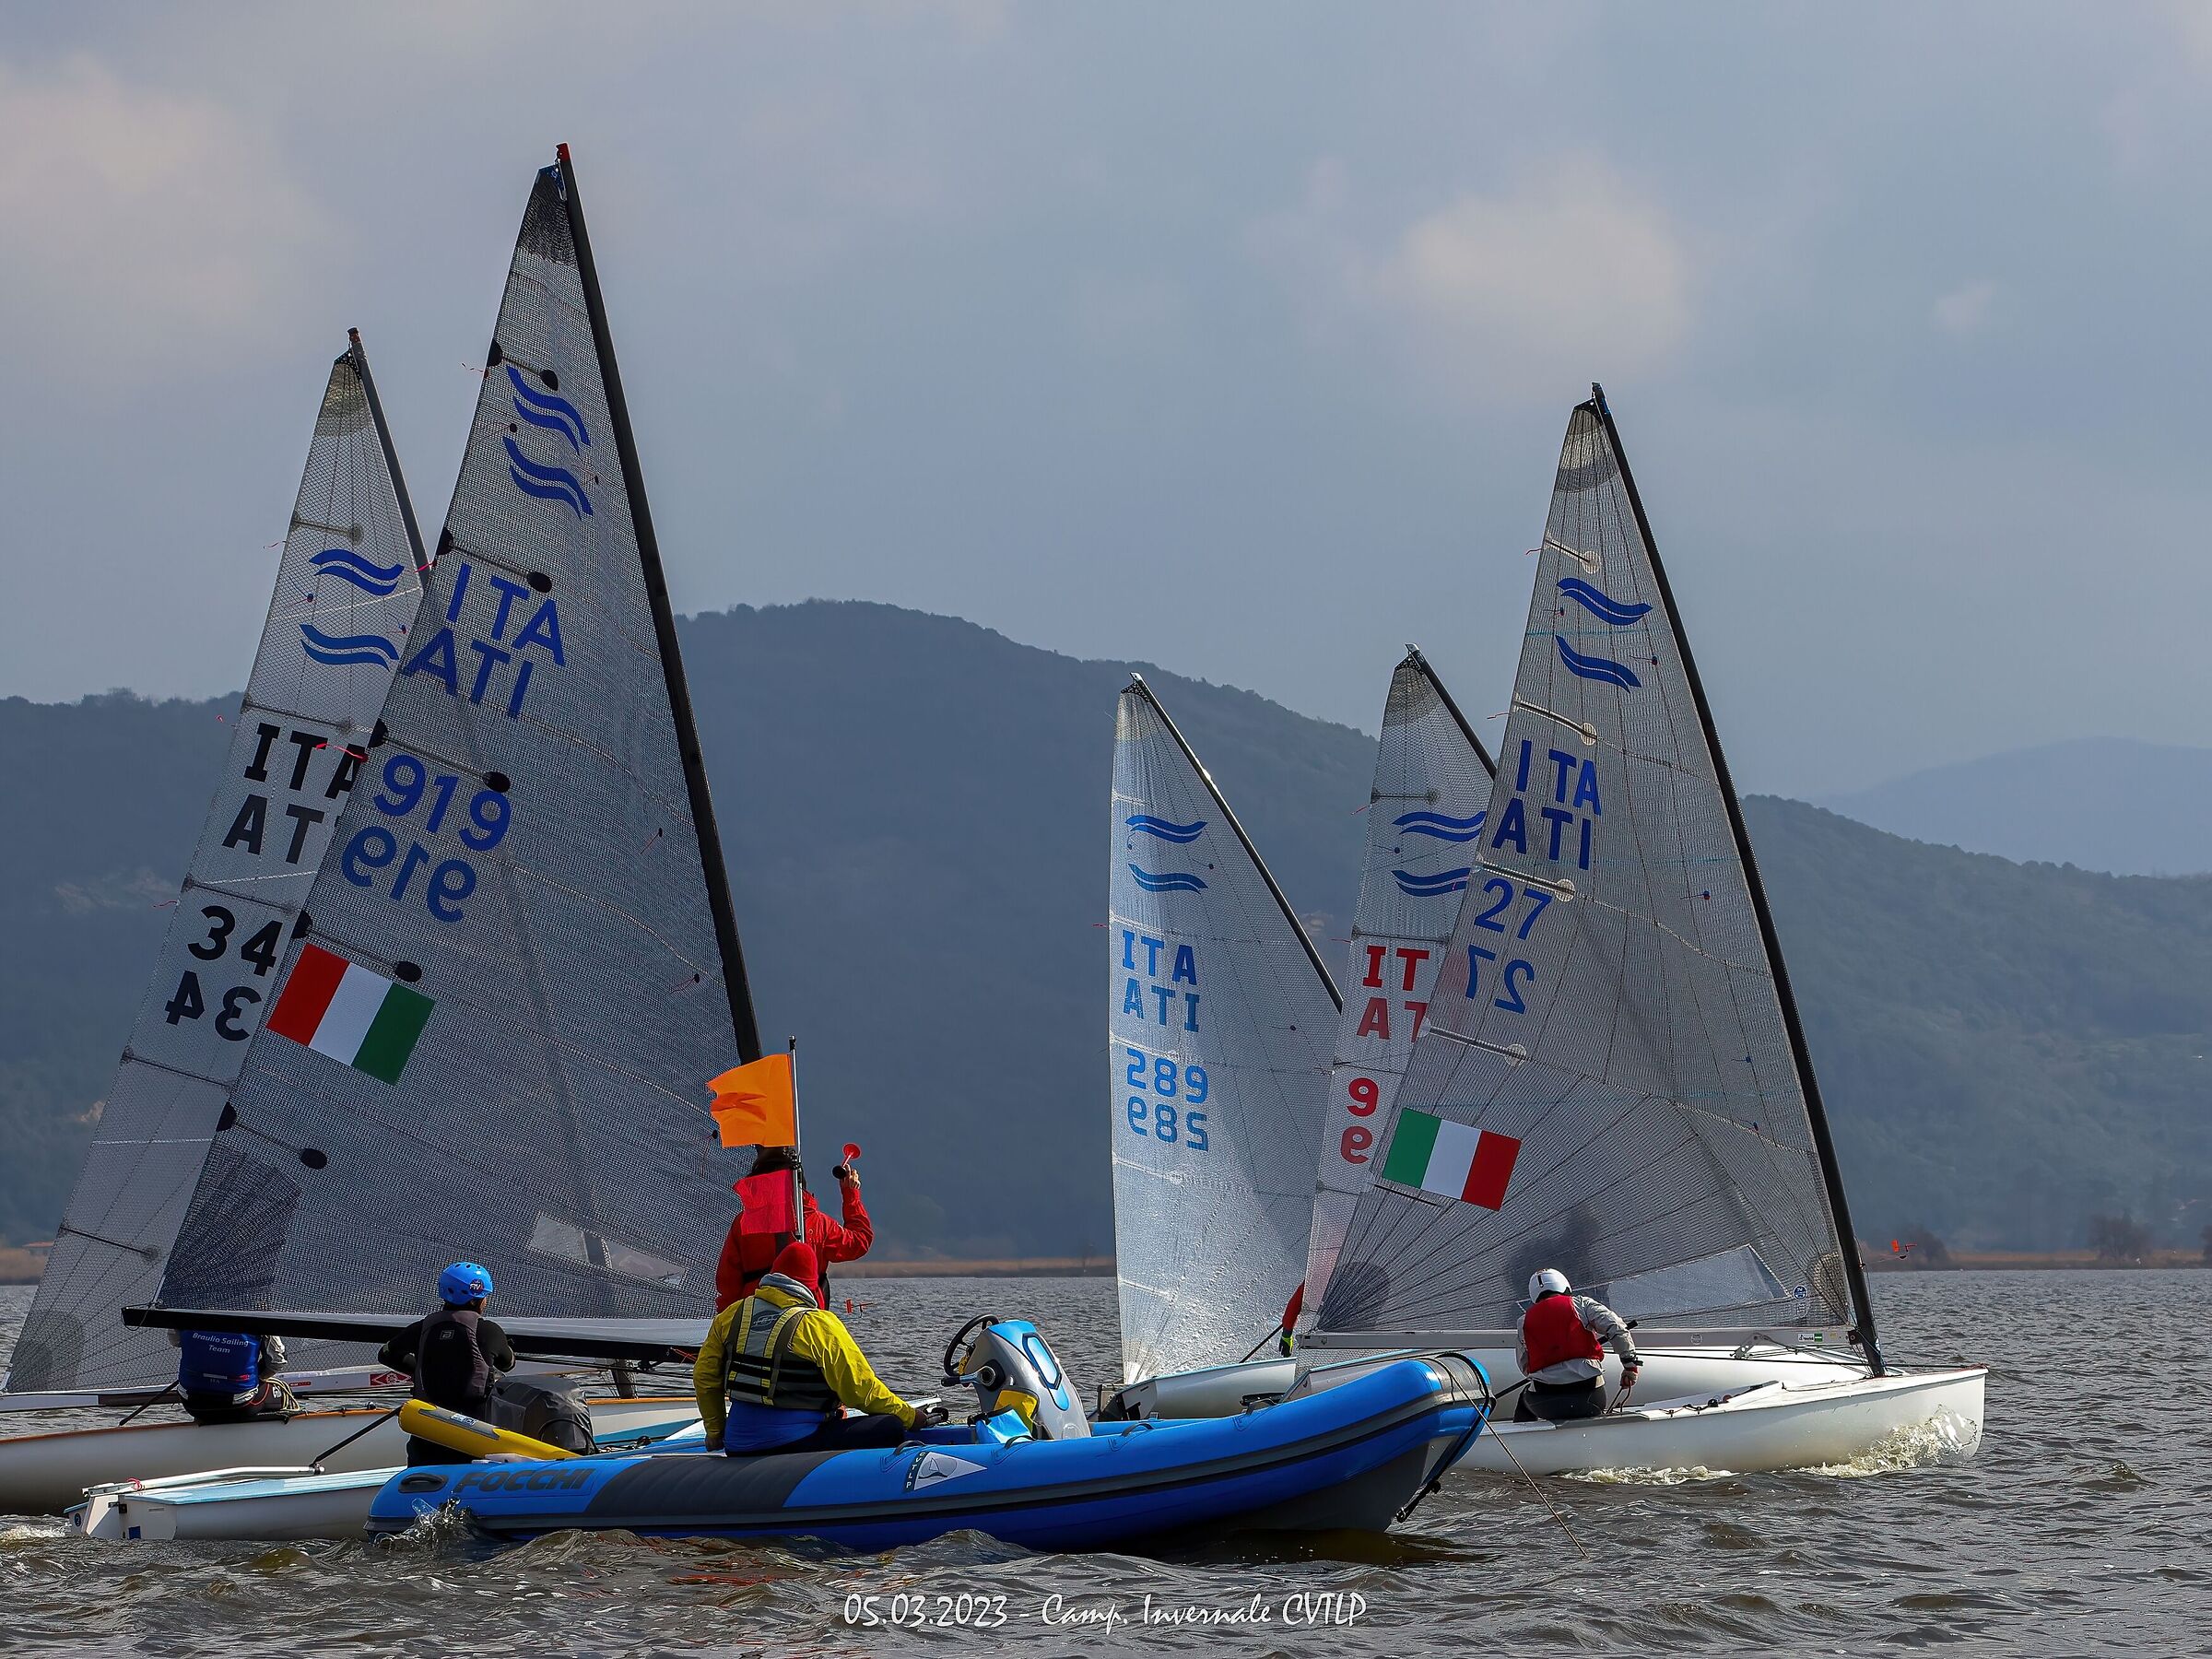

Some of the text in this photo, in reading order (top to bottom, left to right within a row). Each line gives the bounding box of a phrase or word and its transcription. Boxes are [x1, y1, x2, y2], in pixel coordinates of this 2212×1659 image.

[446, 563, 566, 666] ITA
[372, 754, 512, 851] 919
[1515, 740, 1602, 816] ITA
[1475, 877, 1552, 941] 27
[187, 905, 283, 977] 34
[1122, 929, 1197, 986] ITA
[1126, 1048, 1208, 1104] 289
[192, 1332, 249, 1347] Braulio Sailing
[208, 1345, 230, 1354] Team
[453, 1468, 596, 1493] FOCCHI
